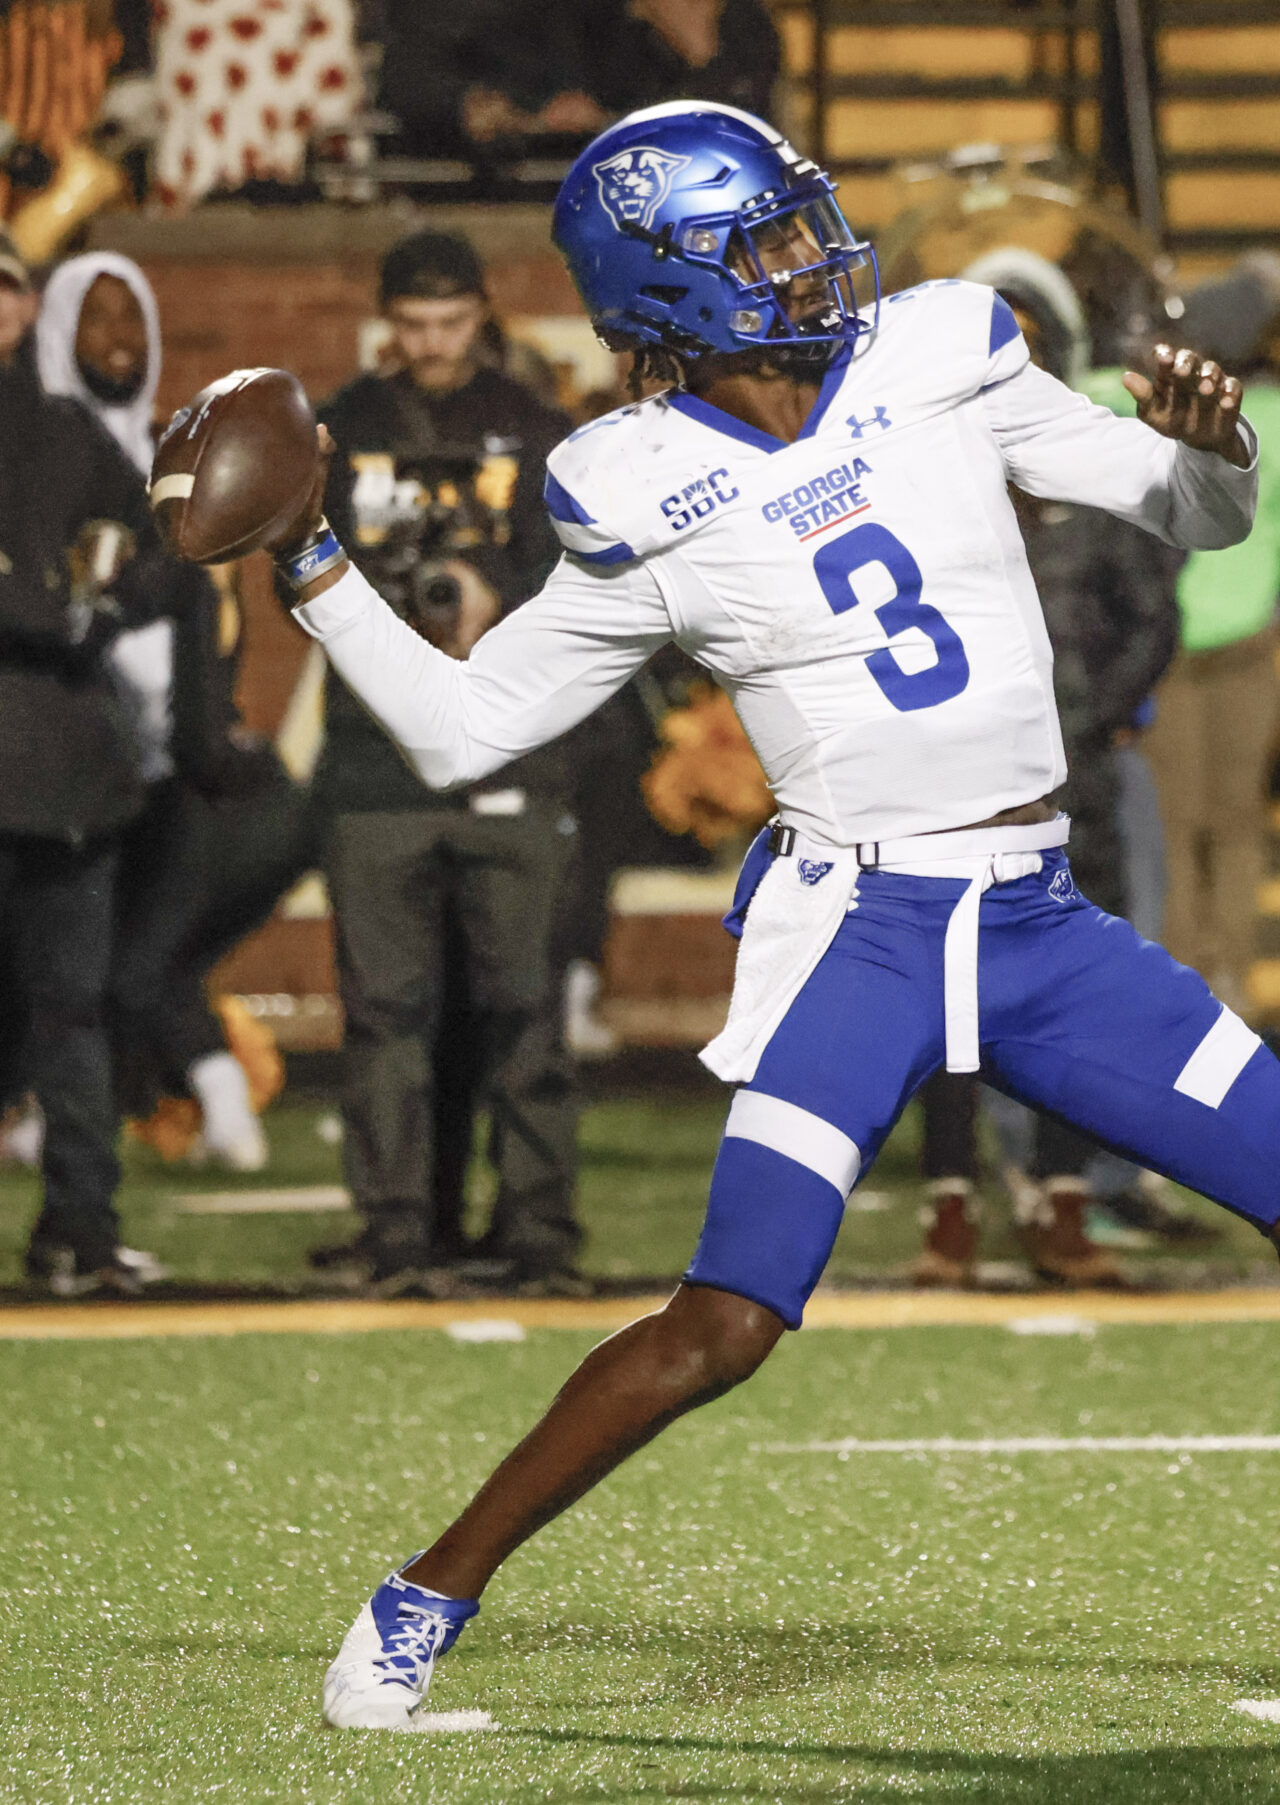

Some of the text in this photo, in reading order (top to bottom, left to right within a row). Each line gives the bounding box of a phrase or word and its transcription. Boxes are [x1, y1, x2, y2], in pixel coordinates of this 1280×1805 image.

[660, 467, 740, 531] SBC
[761, 457, 873, 523] GEORGIA
[789, 483, 868, 536] STATE
[813, 522, 970, 712] 3
